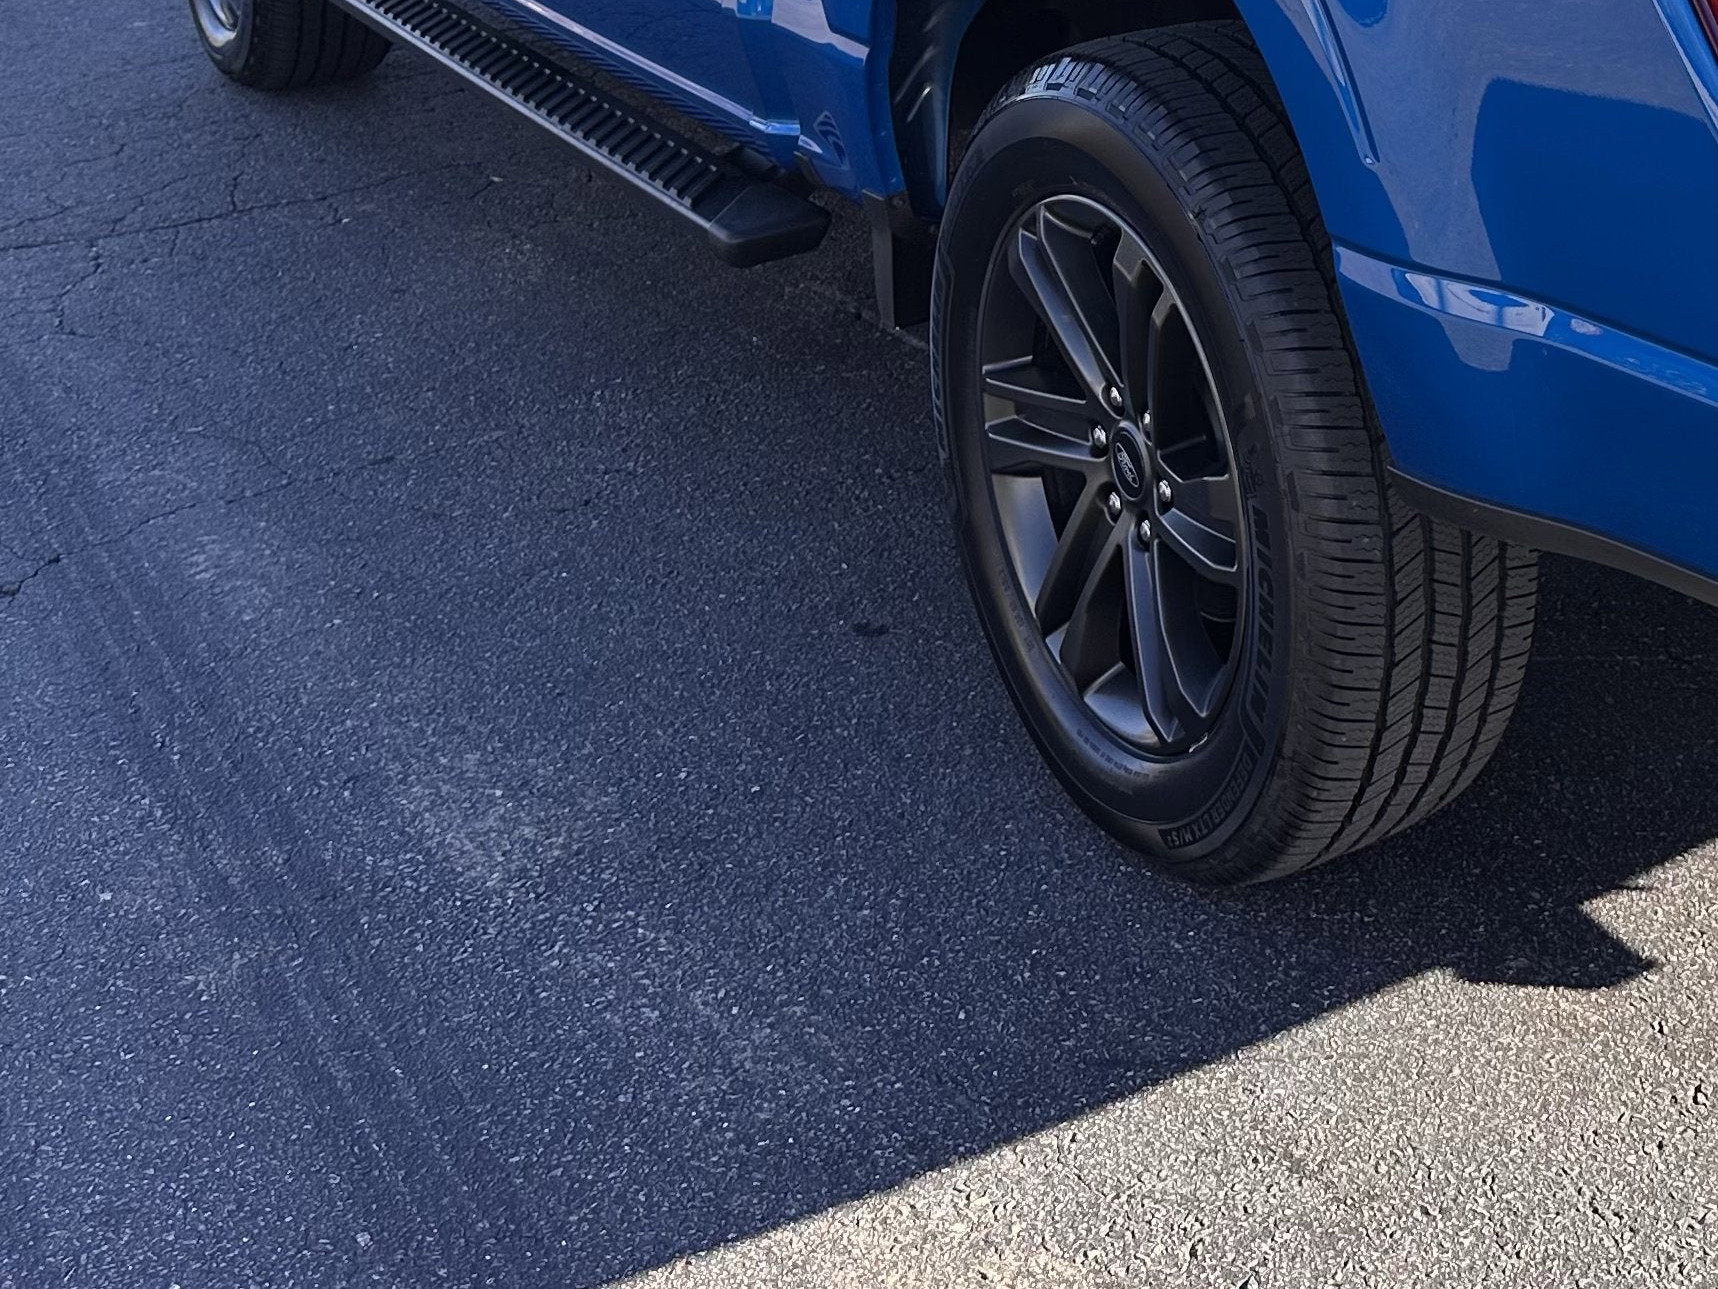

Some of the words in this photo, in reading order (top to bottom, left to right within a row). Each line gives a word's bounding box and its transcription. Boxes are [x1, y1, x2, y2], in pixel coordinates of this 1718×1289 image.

[1252, 503, 1275, 723] MICHELIN
[1210, 751, 1254, 824] DEFENDER
[1191, 812, 1214, 839] LTX
